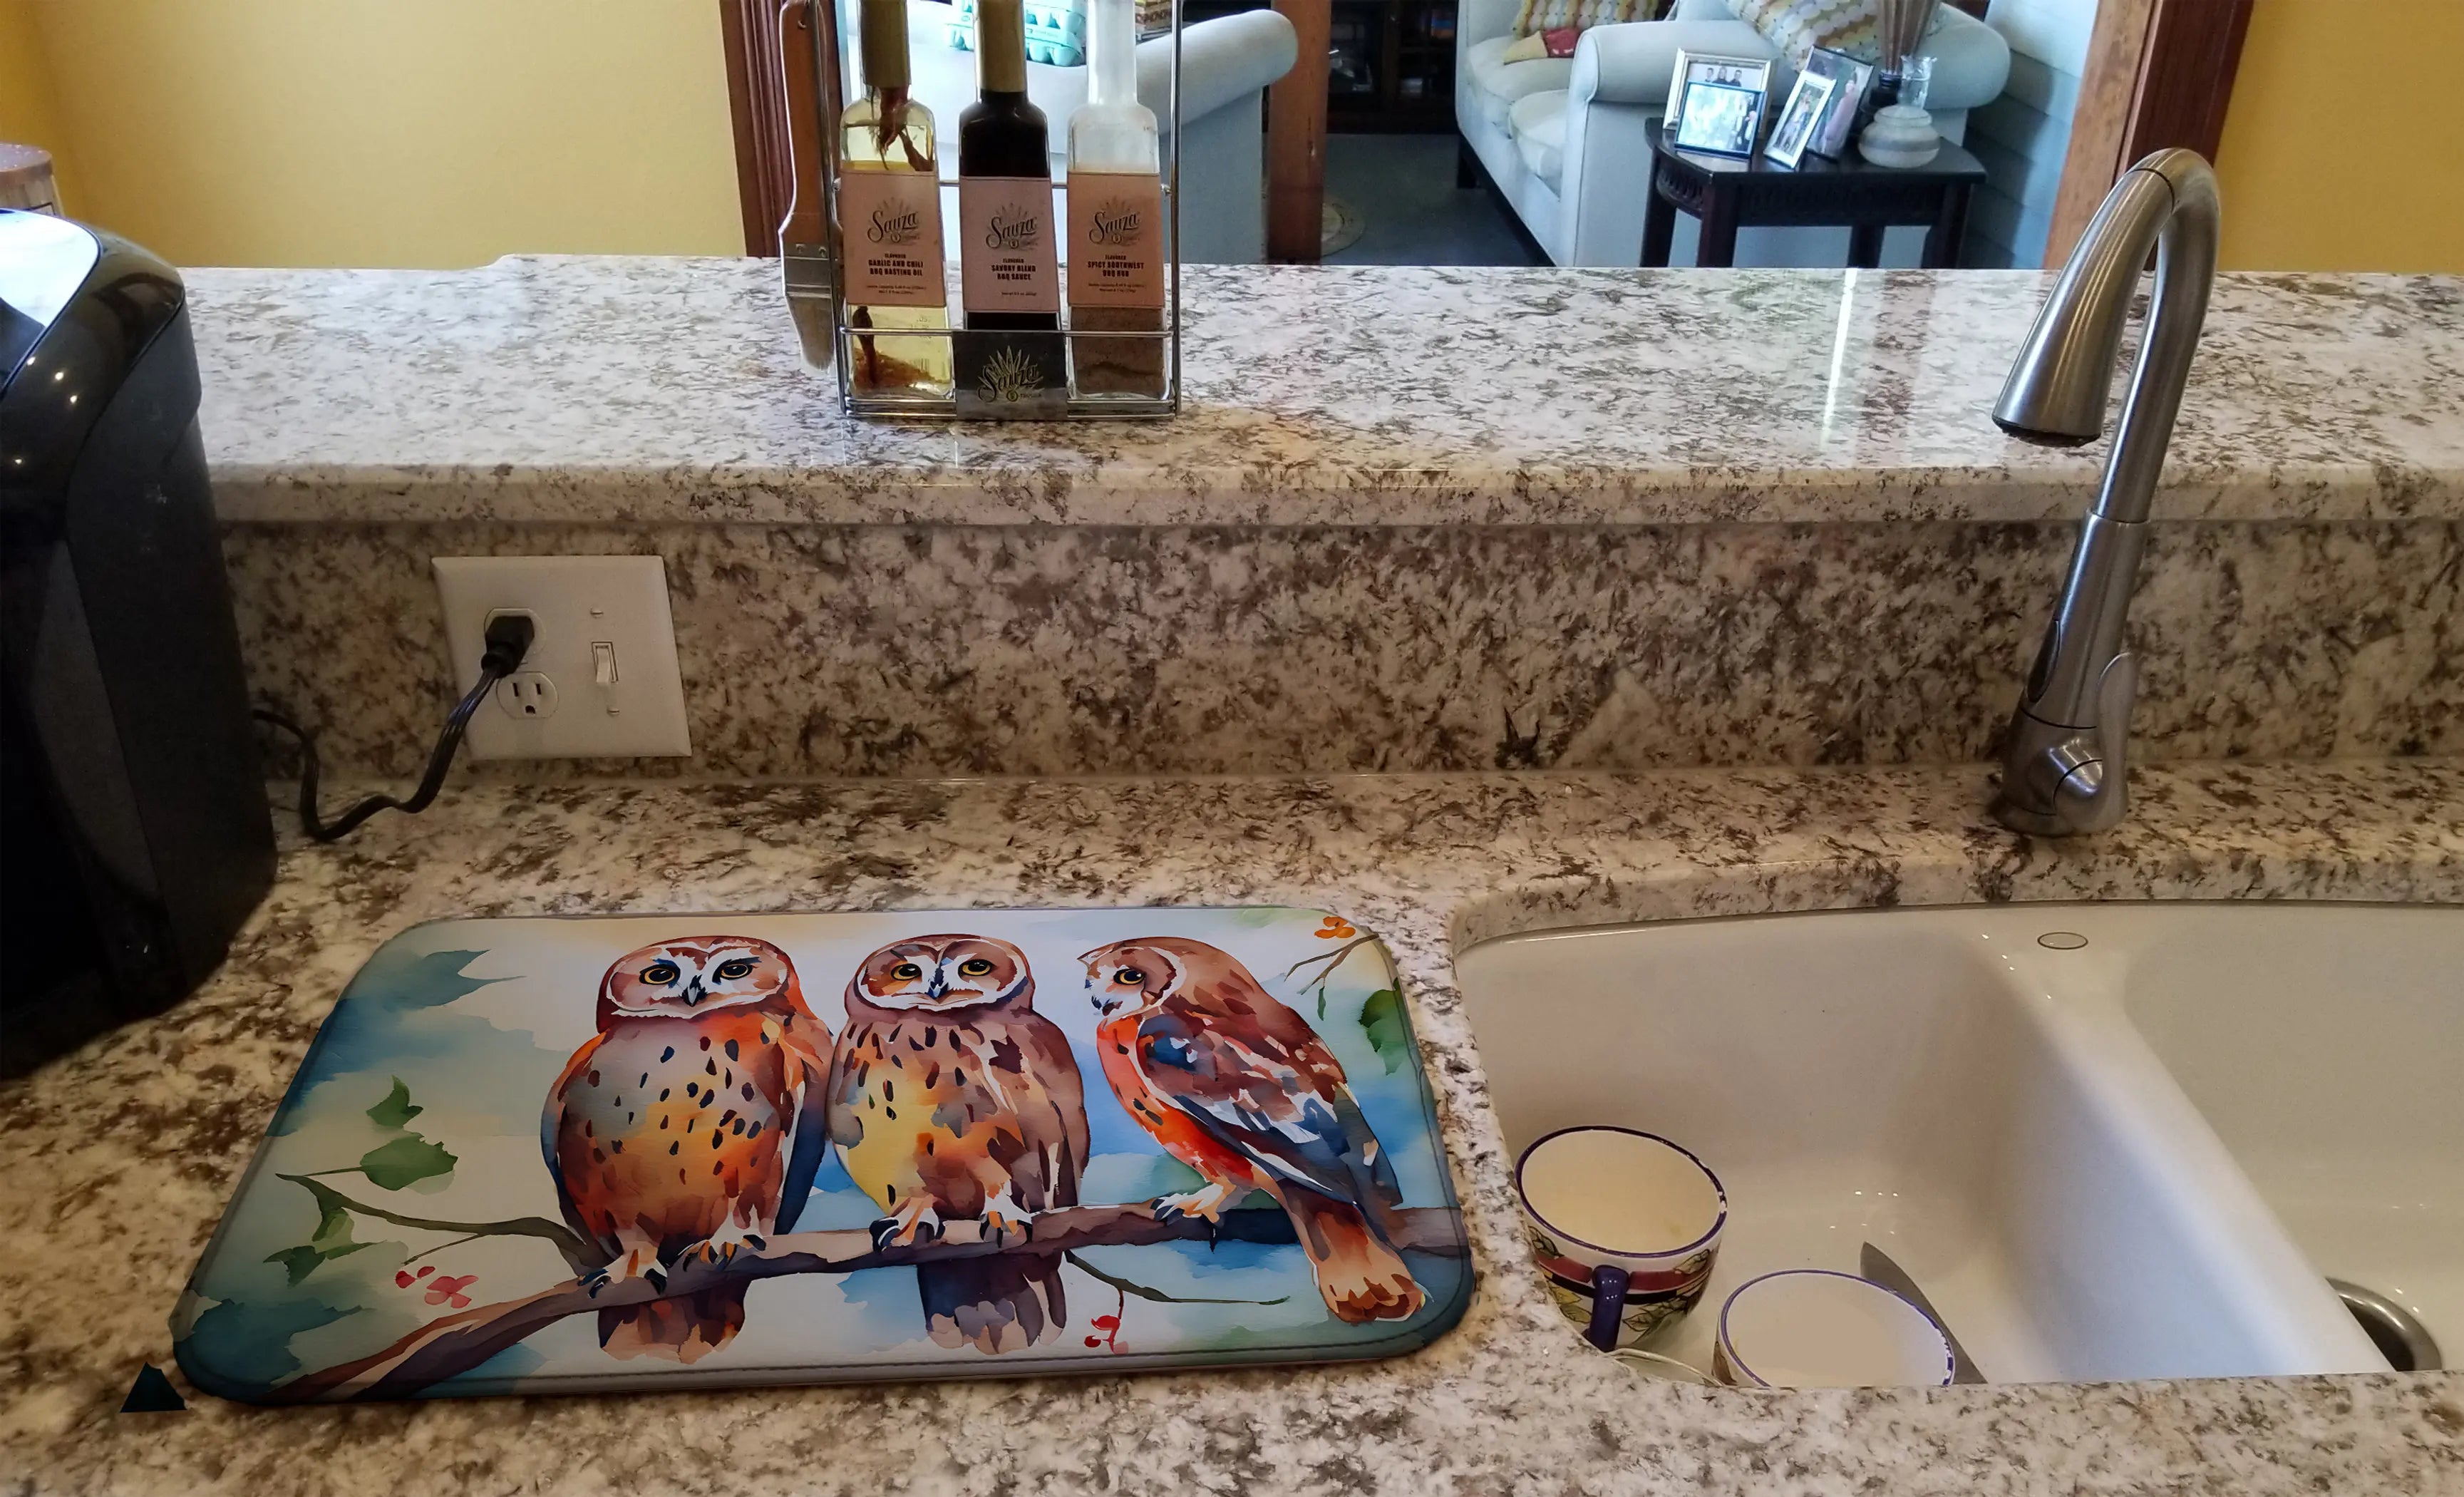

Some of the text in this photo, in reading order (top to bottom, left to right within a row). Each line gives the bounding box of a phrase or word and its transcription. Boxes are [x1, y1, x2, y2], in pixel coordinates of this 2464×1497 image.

[867, 210, 919, 243] Sauza
[986, 216, 1037, 250] Sauza
[1088, 211, 1140, 245] Sauza
[977, 364, 1039, 403] Sauza
